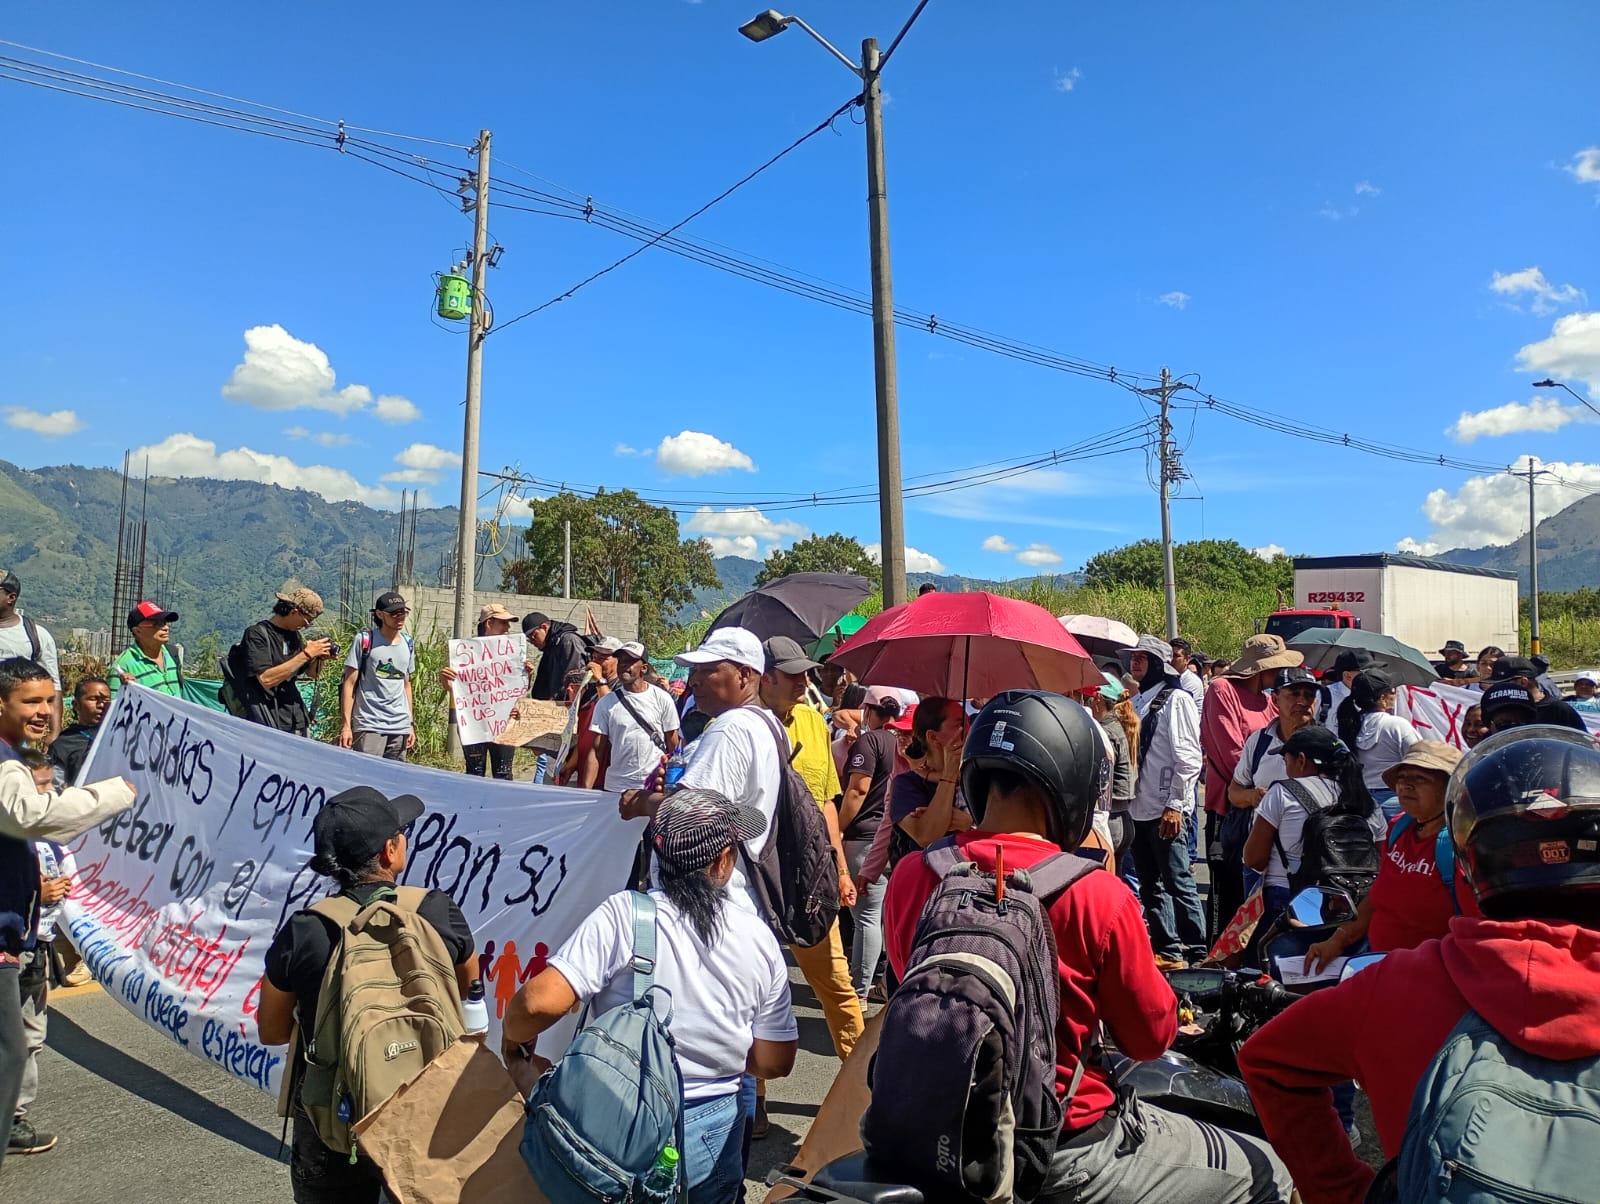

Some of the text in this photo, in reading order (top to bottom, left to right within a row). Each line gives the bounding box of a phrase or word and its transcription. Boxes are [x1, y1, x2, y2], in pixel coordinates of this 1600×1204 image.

[1308, 592, 1365, 603] R29432
[481, 643, 493, 661] A
[498, 640, 514, 656] LA
[472, 694, 487, 708] AL
[461, 708, 496, 727] A LAS
[1542, 848, 1567, 859] DOT
[202, 1018, 280, 1090] esperar
[936, 1134, 950, 1173] TOTTO
